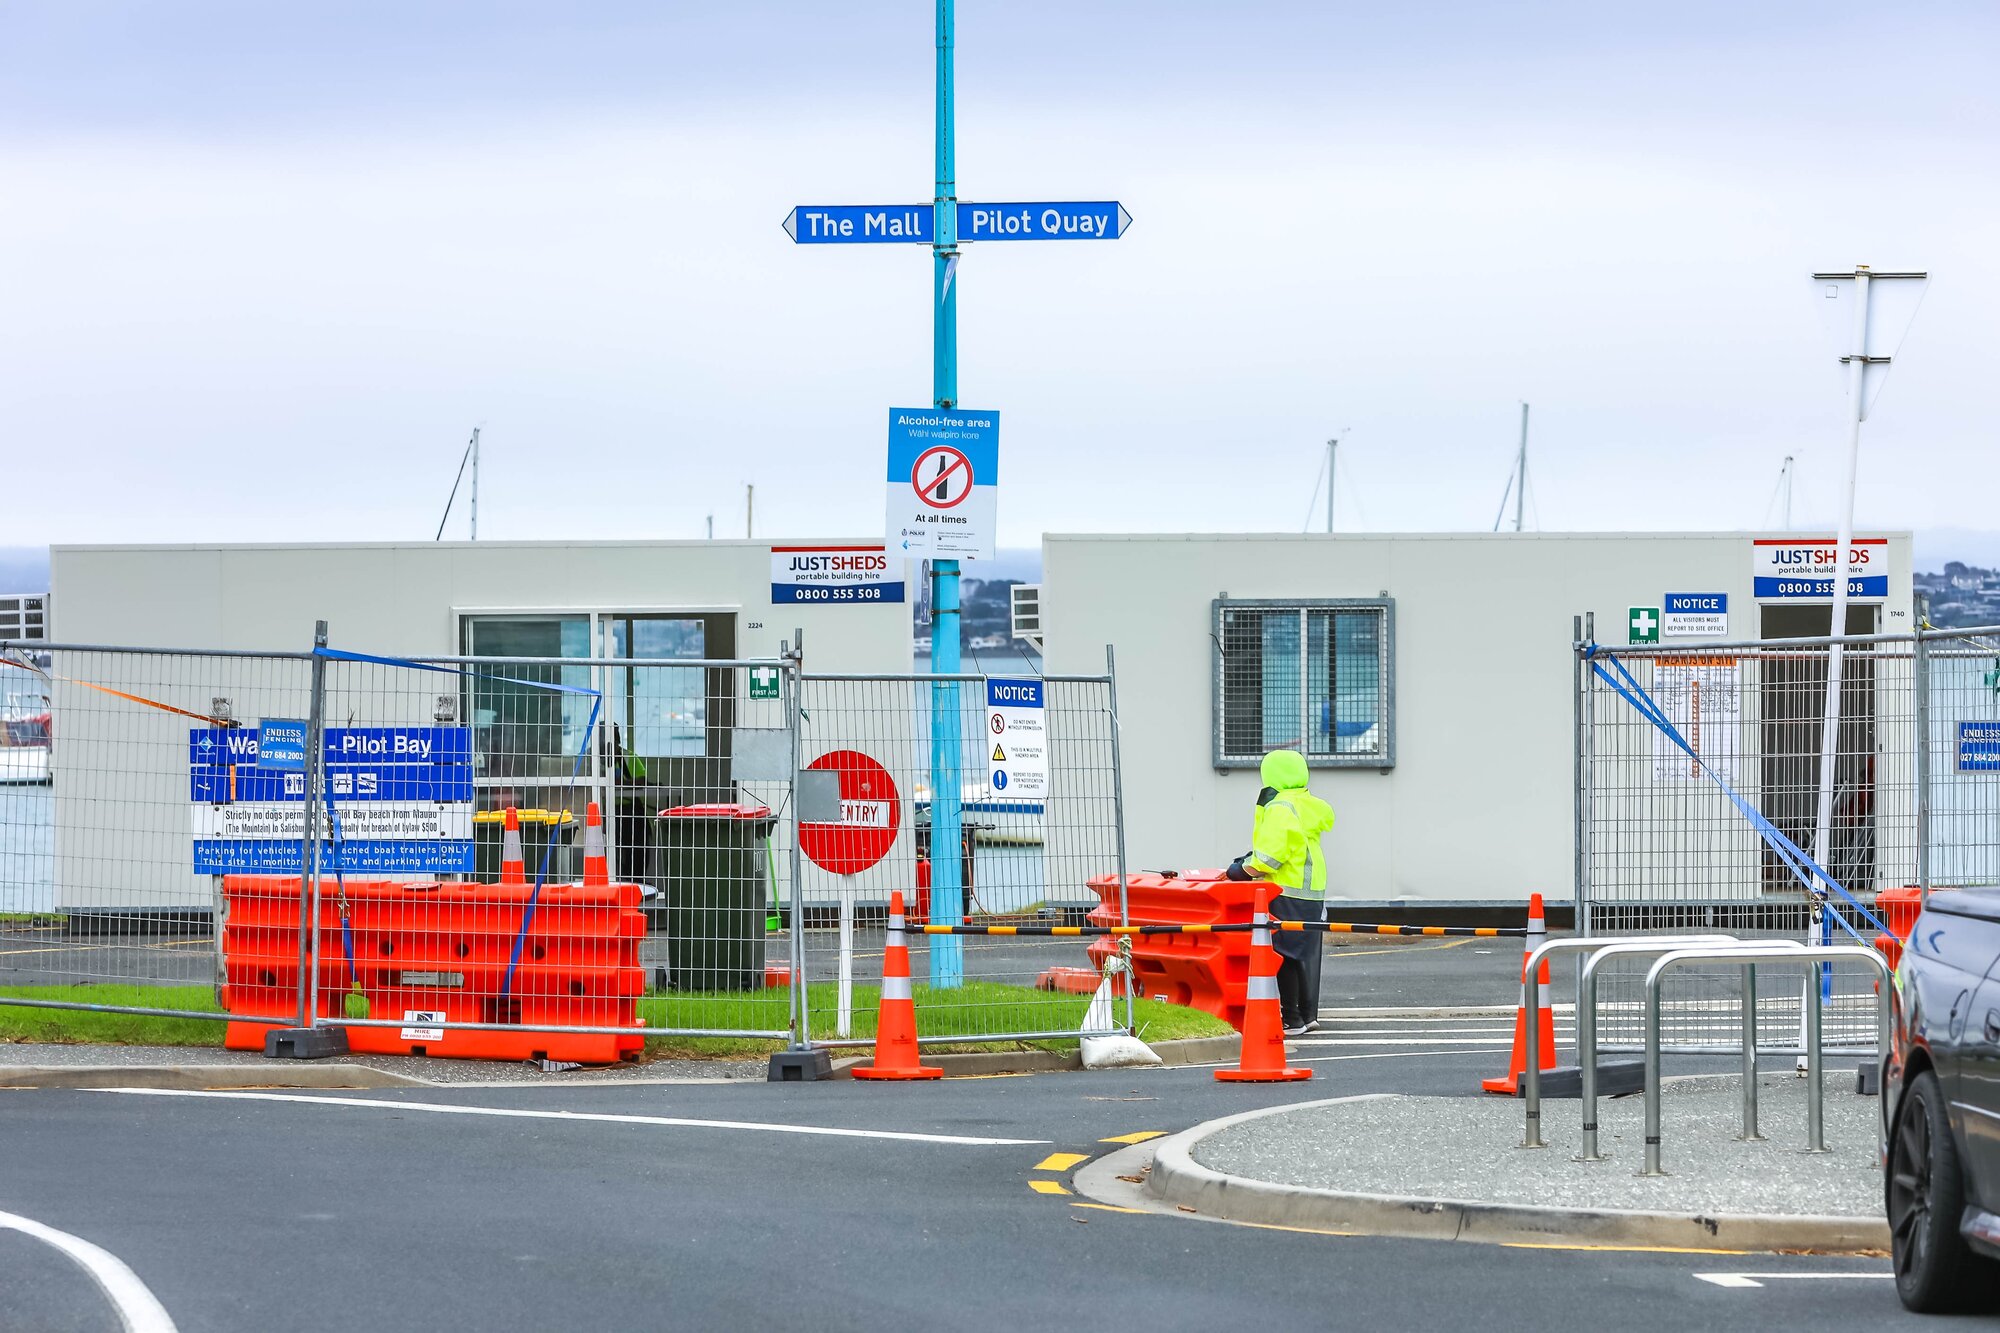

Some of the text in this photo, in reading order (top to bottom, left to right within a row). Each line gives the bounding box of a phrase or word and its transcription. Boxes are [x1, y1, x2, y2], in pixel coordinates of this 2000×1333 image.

[806, 212, 922, 236] The Mall
[972, 209, 1109, 237] Pilot Quay
[898, 415, 991, 428] Alcohol-free area
[931, 430, 960, 440] waipiro
[961, 431, 980, 439] kore
[915, 514, 967, 524] At all times
[1772, 550, 1869, 564] JUSTSHDS
[789, 556, 887, 571] JUSTSHEDS
[1778, 566, 1812, 575] portable
[796, 571, 880, 581] portable building hire
[1778, 583, 1864, 593] 0800 555 08
[796, 588, 881, 599] 0800 555 508
[1673, 599, 1719, 608] NOTICE
[994, 686, 1036, 701] NOTICE
[266, 729, 301, 737] ENDLESS
[1964, 729, 2000, 738] ENDLESS
[342, 736, 387, 754] Pilot
[394, 736, 432, 758] Bay
[261, 750, 303, 760] 027 684 2003
[1960, 753, 1972, 761] 027
[1988, 753, 2000, 761] 200
[225, 810, 251, 821] Strictly
[265, 810, 283, 822] dogs
[285, 811, 317, 821] permie
[353, 810, 366, 821] Bay
[369, 810, 390, 819] beach
[393, 810, 410, 819] from
[840, 804, 878, 822] ENTRY
[225, 824, 239, 833] (The
[241, 824, 271, 833] Mountain)
[272, 824, 279, 832] to
[280, 823, 305, 833] Salisbur
[340, 824, 358, 834] enalty
[361, 823, 370, 832] for
[371, 823, 393, 832] breach
[394, 823, 400, 832] of
[402, 823, 420, 834] bylaw
[421, 822, 438, 832] $500
[198, 847, 235, 856] Parking
[239, 847, 253, 855] for
[257, 847, 297, 855] vehicles
[327, 846, 369, 855] aached
[374, 846, 396, 854] boat
[399, 846, 437, 854] trailers
[441, 846, 469, 854] ONLY
[203, 858, 222, 866] This
[228, 858, 246, 866] site
[362, 857, 380, 865] and
[384, 857, 420, 867] parking
[425, 857, 463, 865] officers
